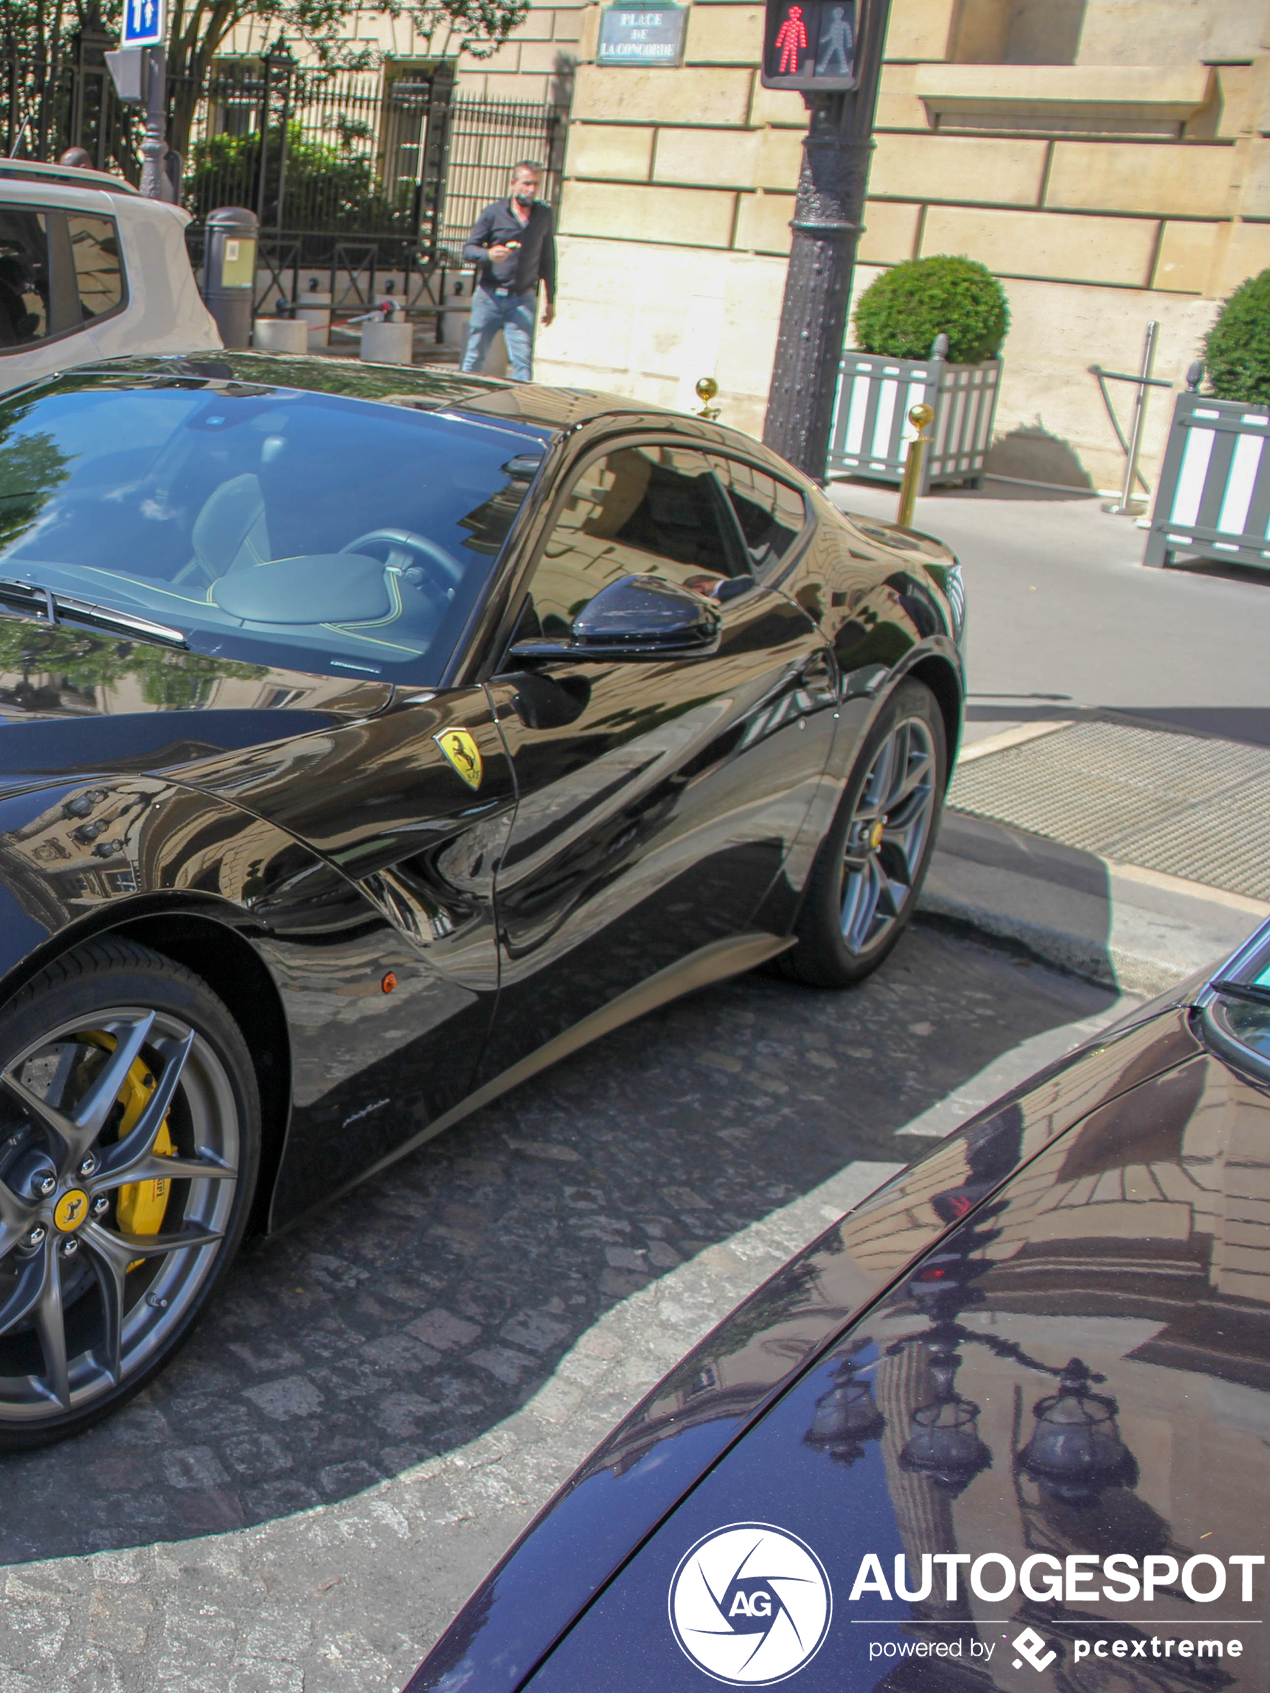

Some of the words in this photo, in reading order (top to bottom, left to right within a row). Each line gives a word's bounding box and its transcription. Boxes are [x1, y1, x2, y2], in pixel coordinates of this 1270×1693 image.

[620, 13, 663, 26] PLACE
[631, 28, 649, 39] DE
[600, 42, 615, 55] LA
[616, 43, 675, 56] CONCORDE
